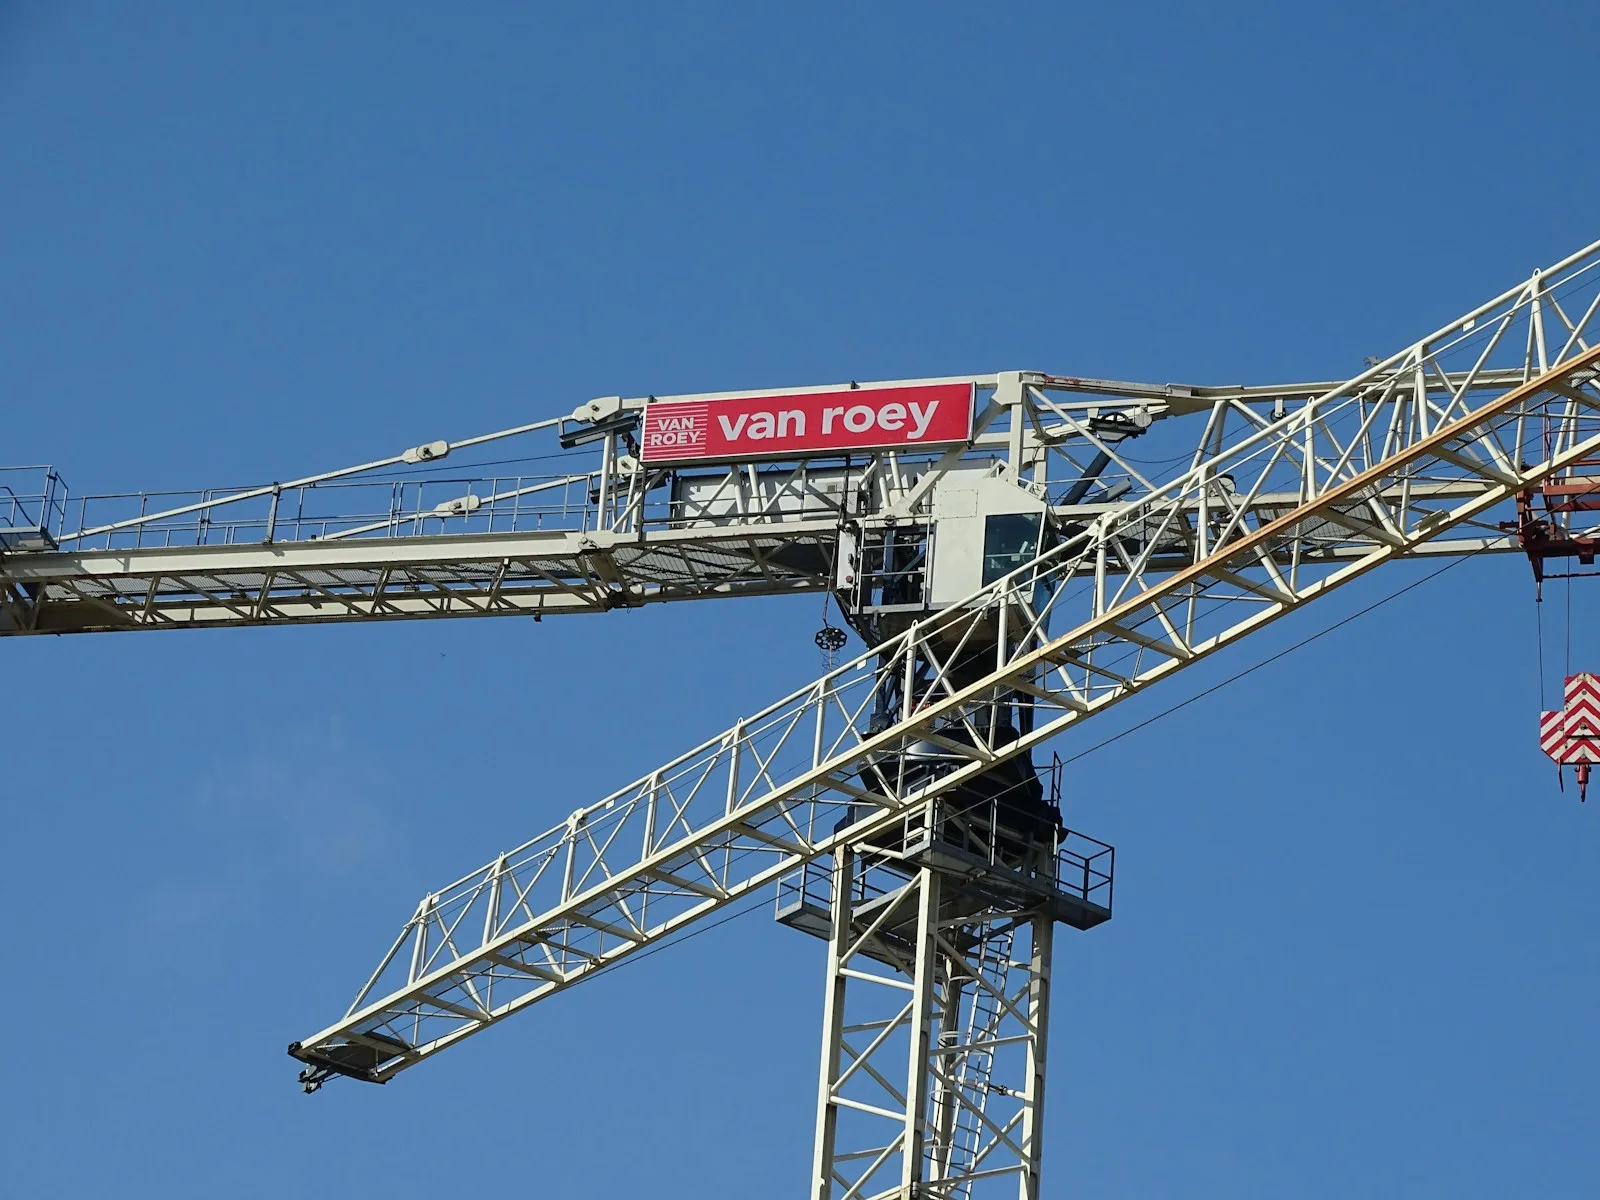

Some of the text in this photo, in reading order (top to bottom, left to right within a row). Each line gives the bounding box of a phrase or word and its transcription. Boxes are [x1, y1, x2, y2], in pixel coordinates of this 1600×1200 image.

[657, 417, 695, 431] VAN
[717, 400, 940, 441] van roey
[650, 430, 701, 446] ROEY
